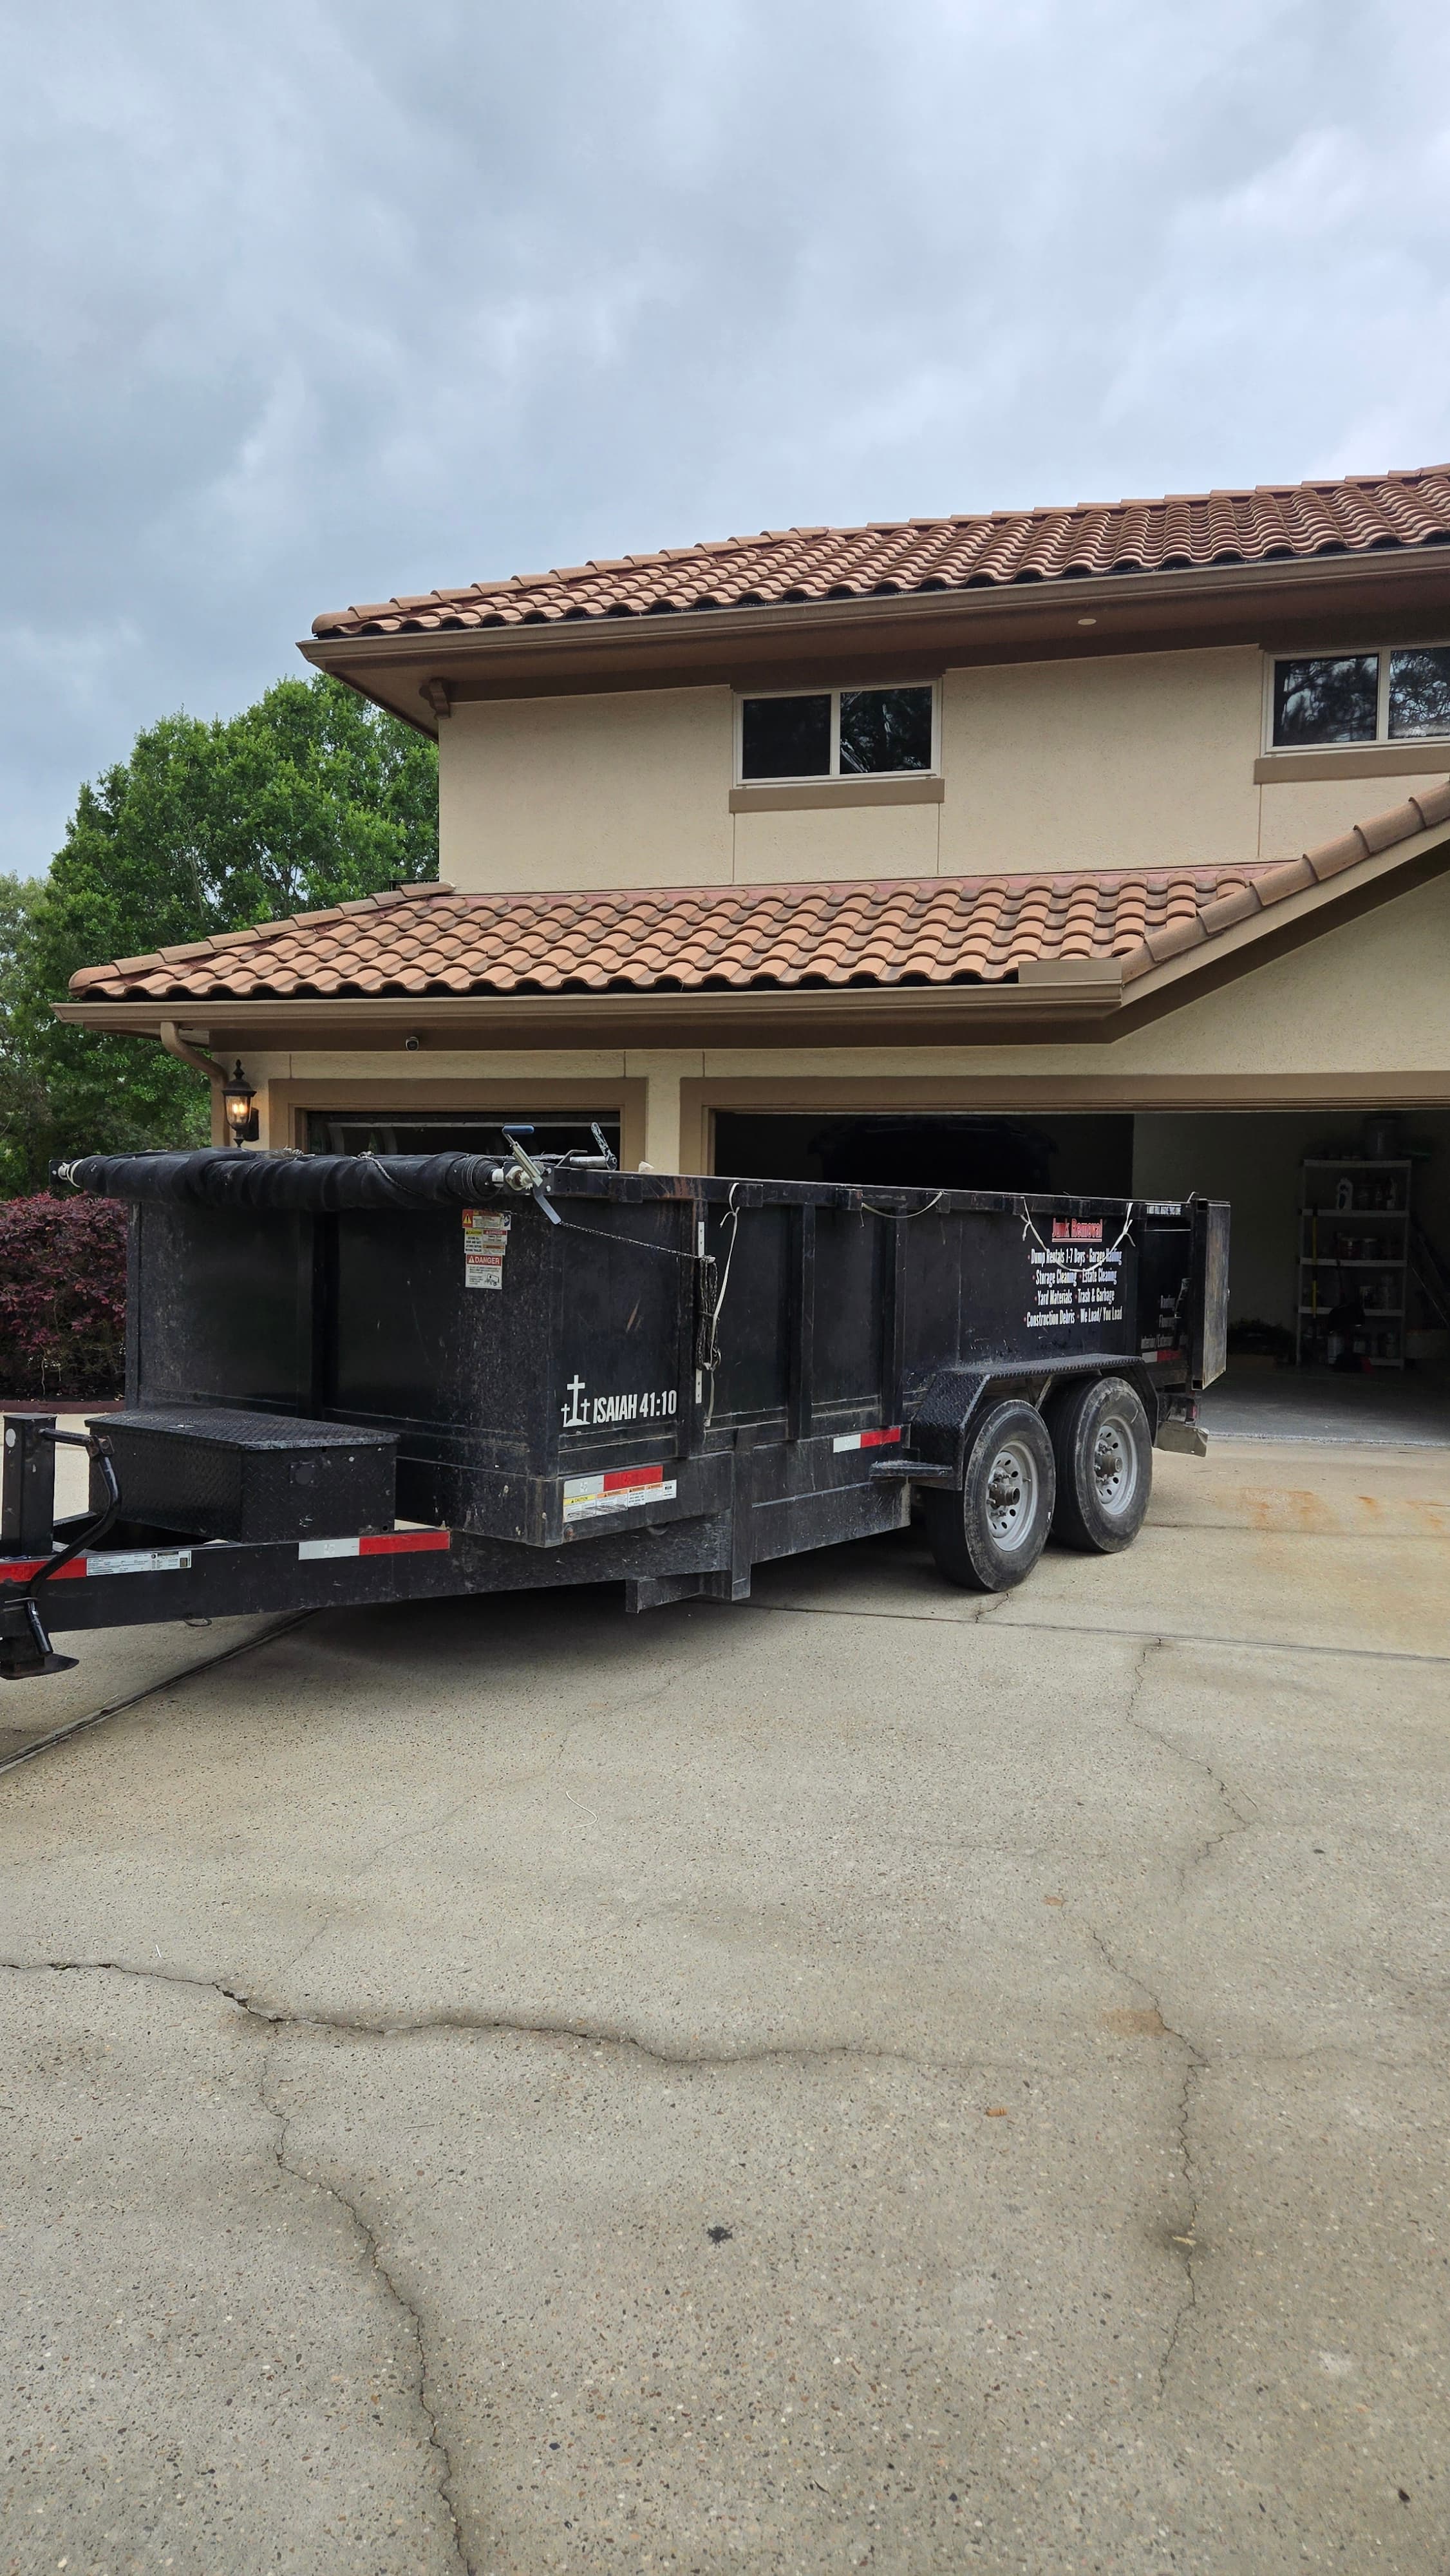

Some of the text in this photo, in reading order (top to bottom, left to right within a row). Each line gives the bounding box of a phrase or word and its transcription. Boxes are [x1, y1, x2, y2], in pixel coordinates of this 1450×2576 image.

[1051, 1217, 1103, 1238] Junk Removal
[475, 1256, 500, 1265] DANGER
[1031, 1248, 1046, 1267] Dump
[1046, 1248, 1065, 1264] Rentals
[1074, 1248, 1086, 1267] Days
[1089, 1248, 1106, 1265] Garage
[1035, 1267, 1118, 1288] Storage Cleaning Estate Cleaning
[1037, 1287, 1115, 1306] Yard Materials Trash & Garbage
[1026, 1310, 1059, 1328] Construction
[1059, 1309, 1075, 1325] Debris
[1080, 1308, 1088, 1323] We
[1103, 1307, 1111, 1321] You
[1112, 1305, 1123, 1320] Load
[592, 1390, 677, 1424] ISAIAH 41:10
